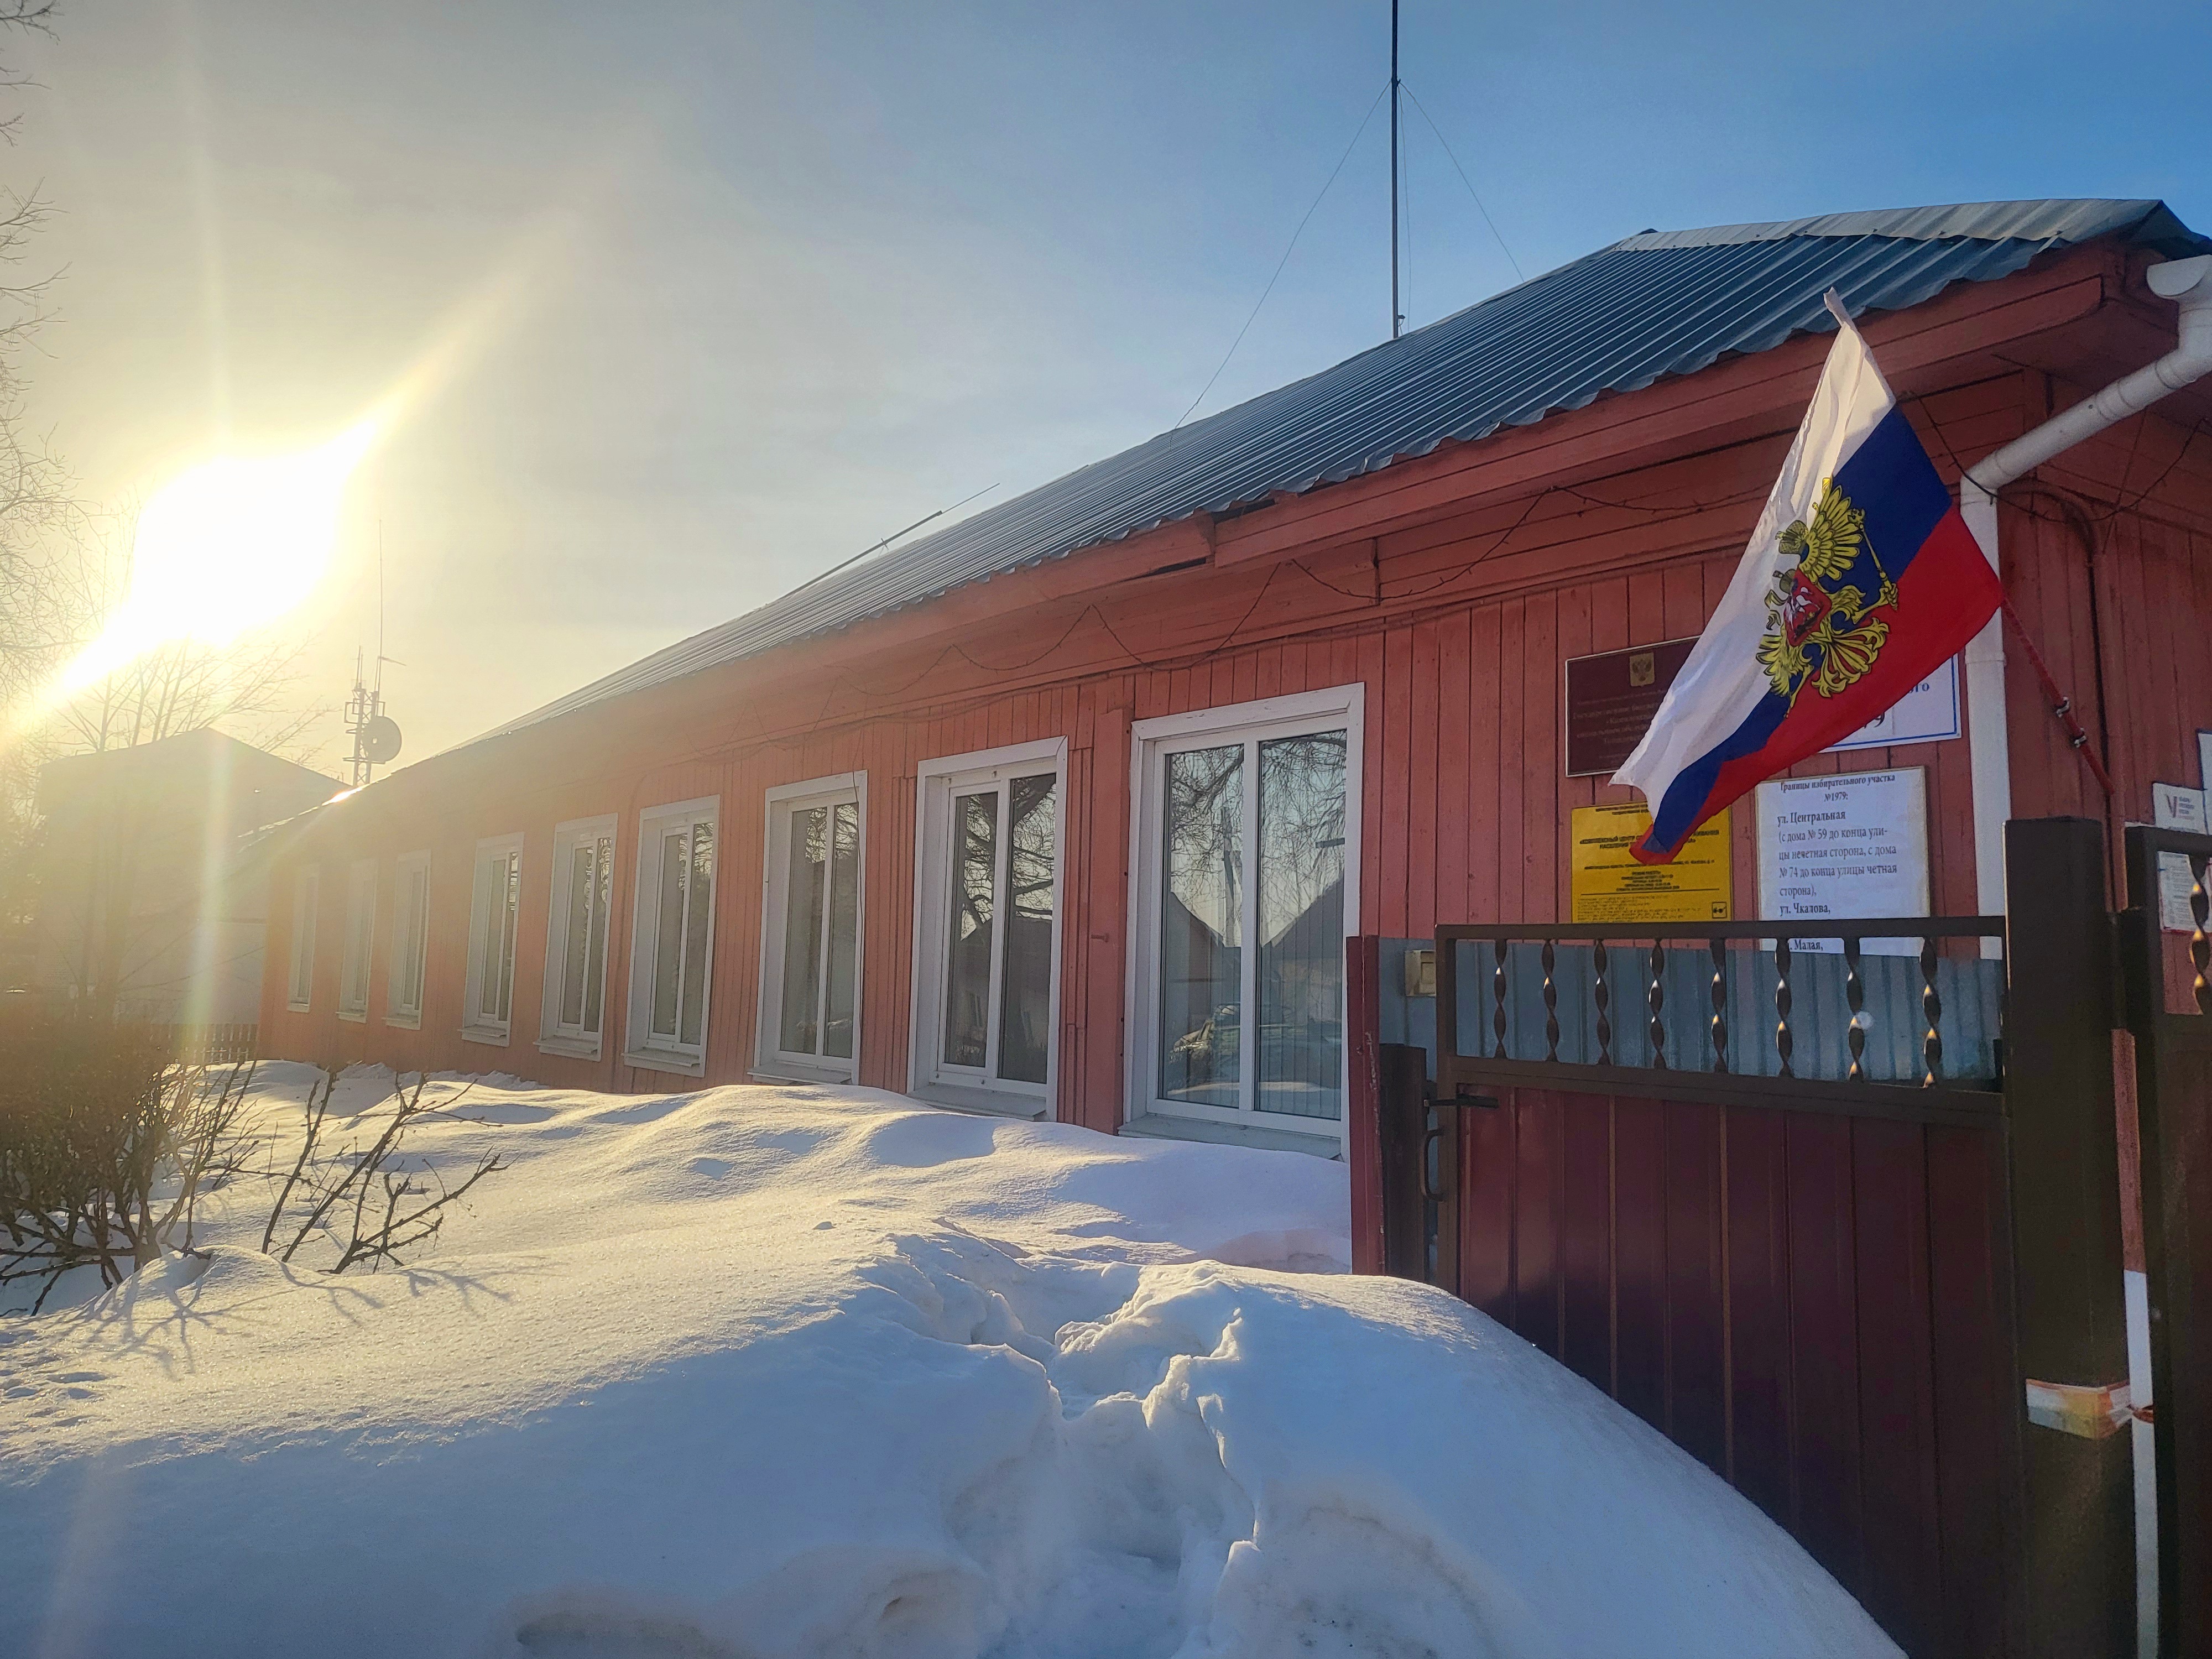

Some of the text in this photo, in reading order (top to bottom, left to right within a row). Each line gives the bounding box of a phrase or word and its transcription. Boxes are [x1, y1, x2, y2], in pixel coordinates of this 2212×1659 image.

[1781, 775, 1896, 793] Границы избирательного участка
[1824, 791, 1849, 802] №1979:
[1777, 811, 1846, 827] ул. Центральная
[1778, 827, 1888, 843] (с дома № 59 до конца ули-
[1778, 846, 1897, 860] цы нечетная сторона, с дома
[1779, 864, 1897, 879] № 74 до конца улицы четная
[1780, 883, 1817, 899] сторона),
[1780, 902, 1830, 916] ул. Чкалова,
[1794, 940, 1823, 951] Малая,
